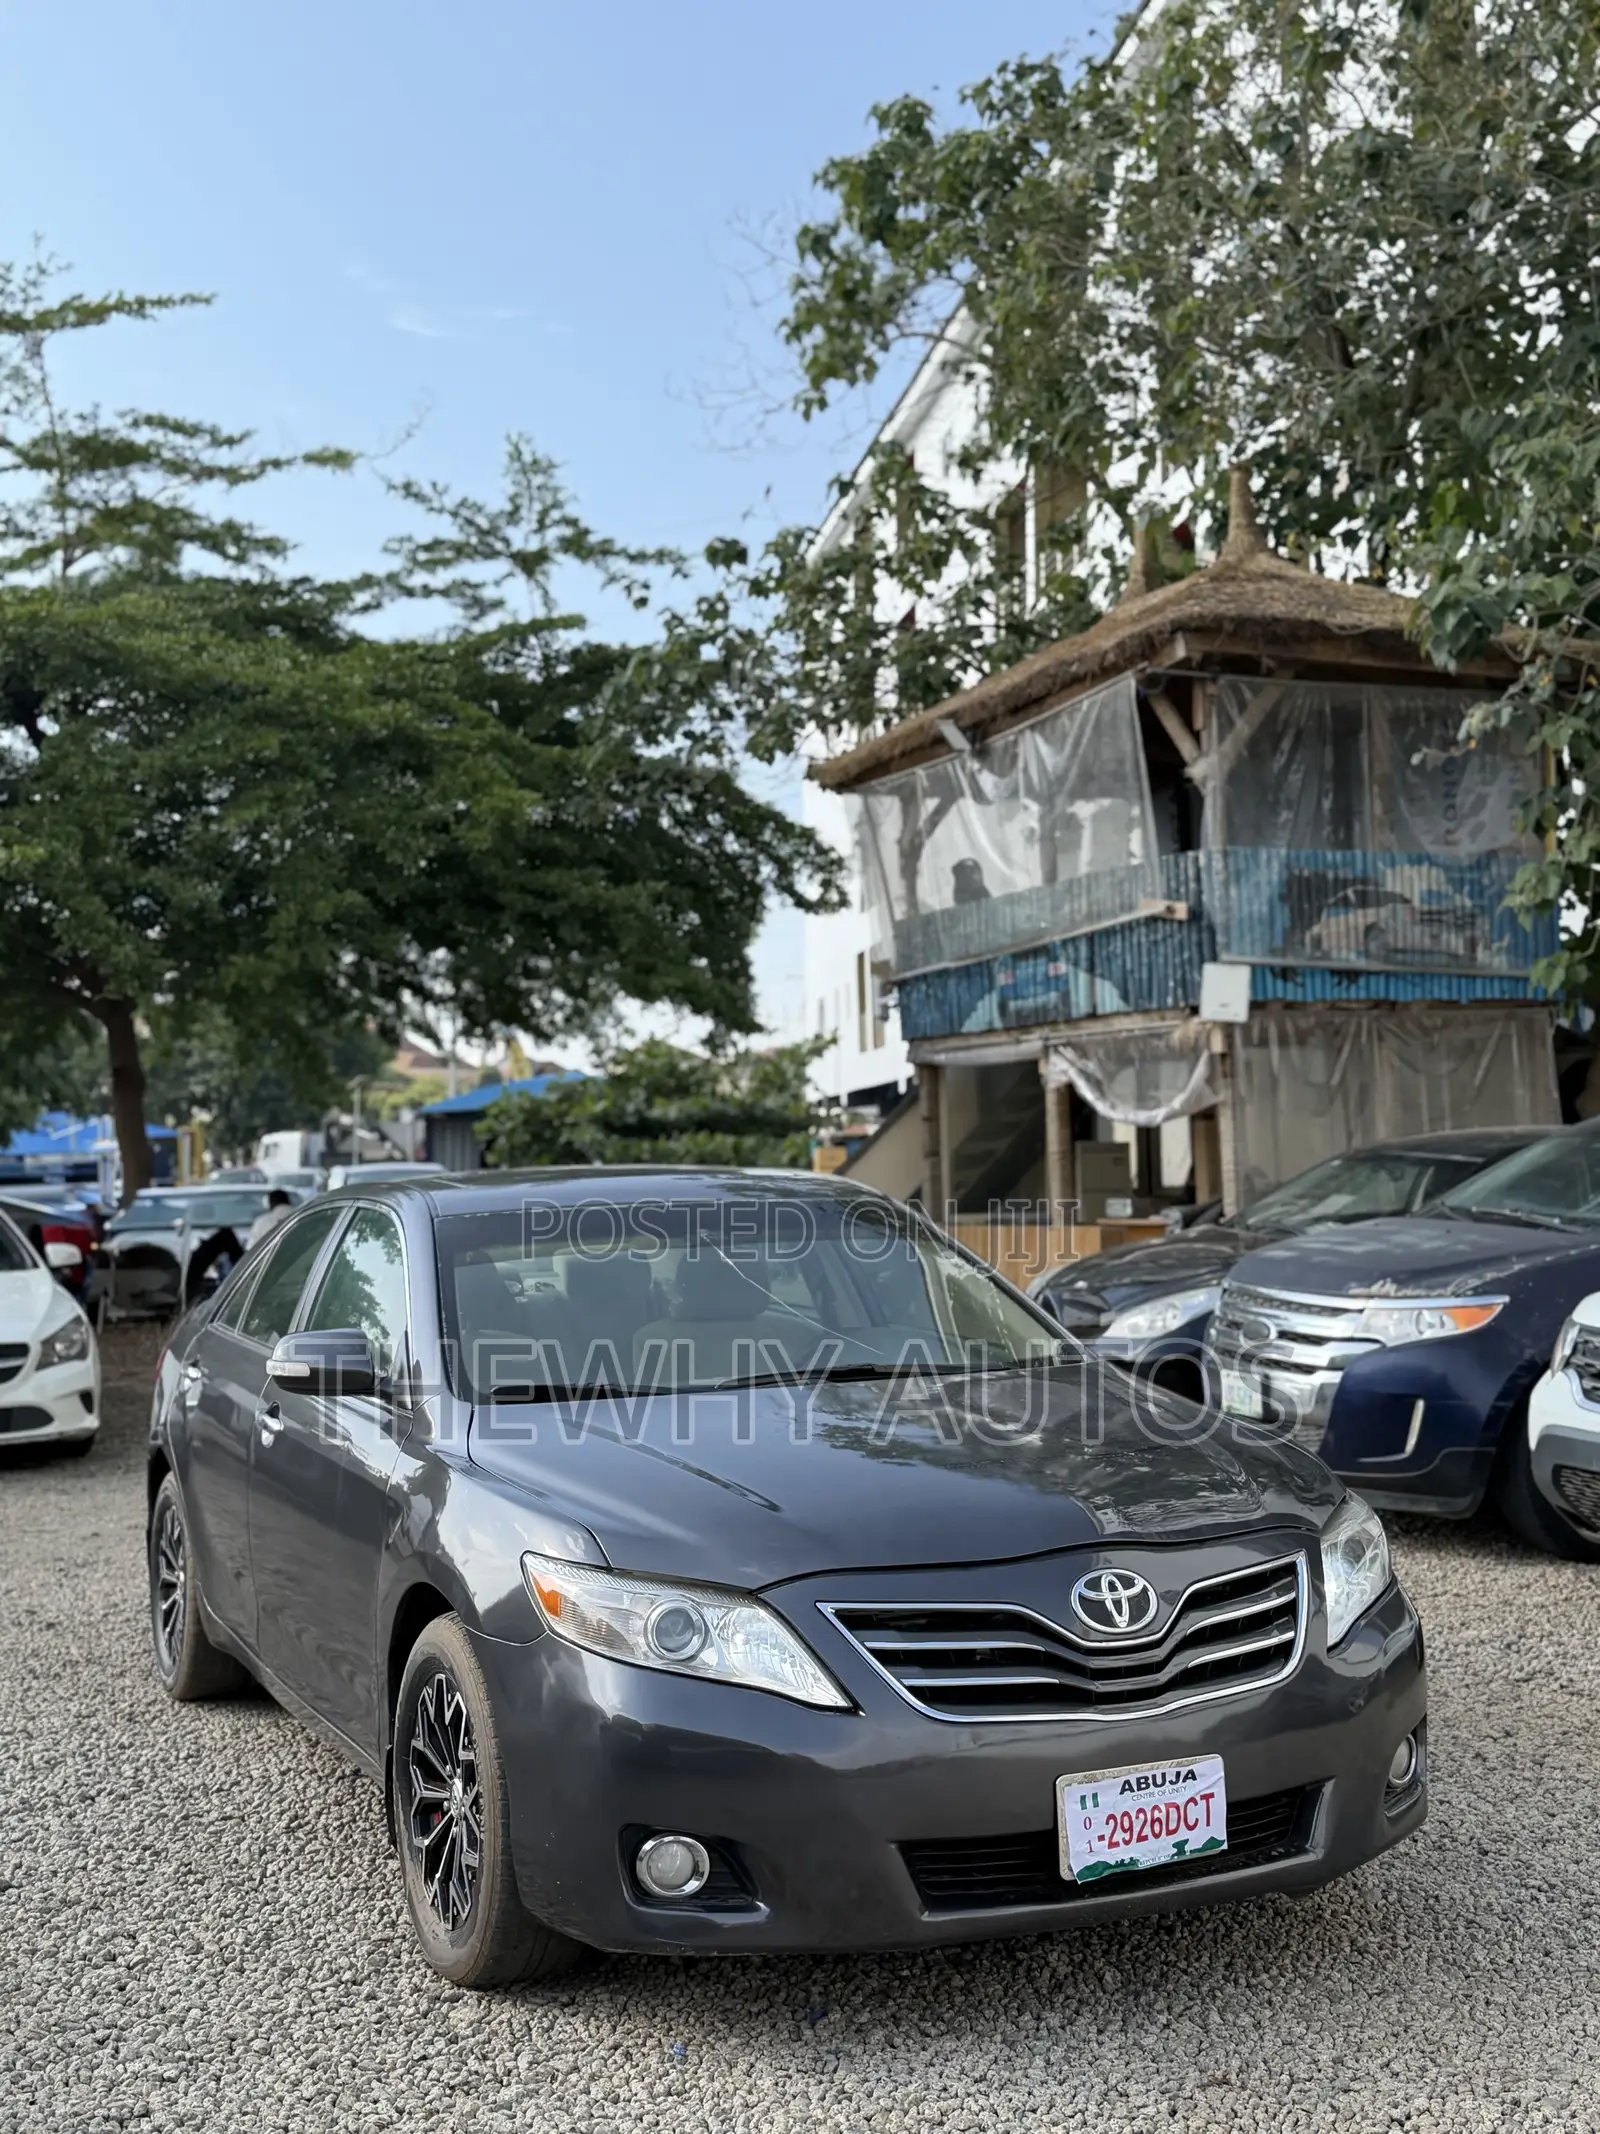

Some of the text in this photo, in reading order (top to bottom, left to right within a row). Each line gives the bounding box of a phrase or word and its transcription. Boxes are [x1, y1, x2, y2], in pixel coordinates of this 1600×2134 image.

[1119, 1769, 1197, 1795] ABUJA
[1131, 1785, 1188, 1802] CENTRE OF UNITY
